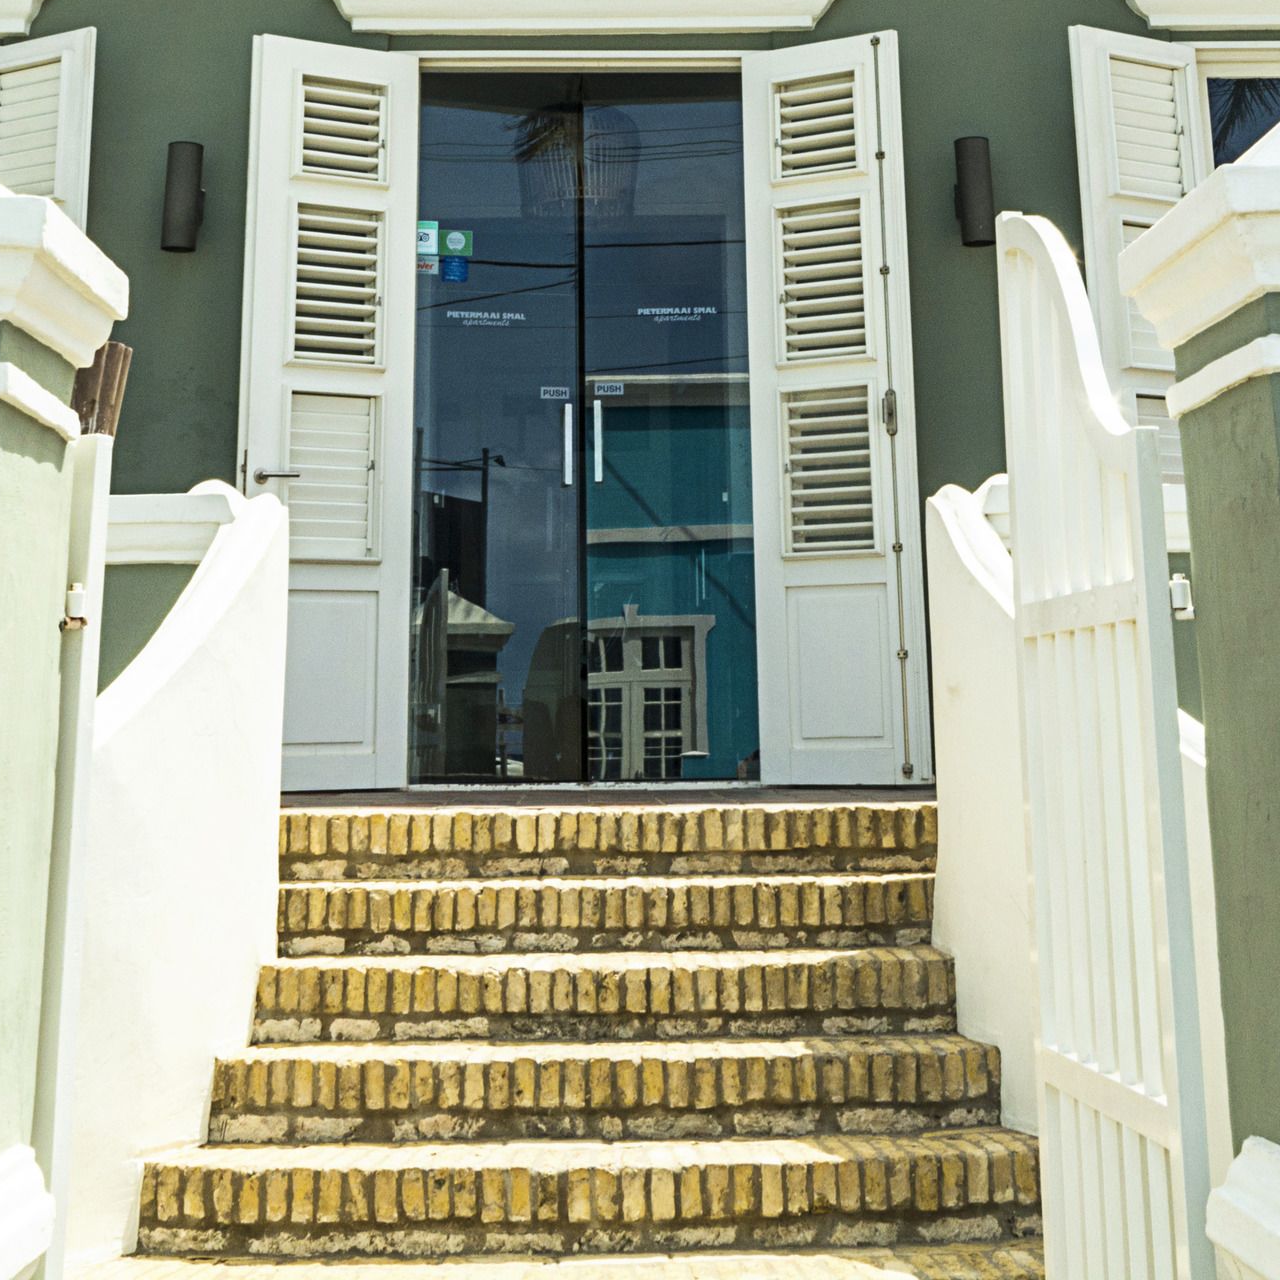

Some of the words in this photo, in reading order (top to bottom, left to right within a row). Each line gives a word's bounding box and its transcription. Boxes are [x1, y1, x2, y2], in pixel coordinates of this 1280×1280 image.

[447, 310, 500, 319] PIETERMAAI
[502, 312, 526, 320] SMAL
[637, 307, 691, 315] PIETERMAAI
[693, 306, 717, 314] SMAL
[543, 389, 567, 397] PUSH
[596, 384, 622, 393] PUSH
